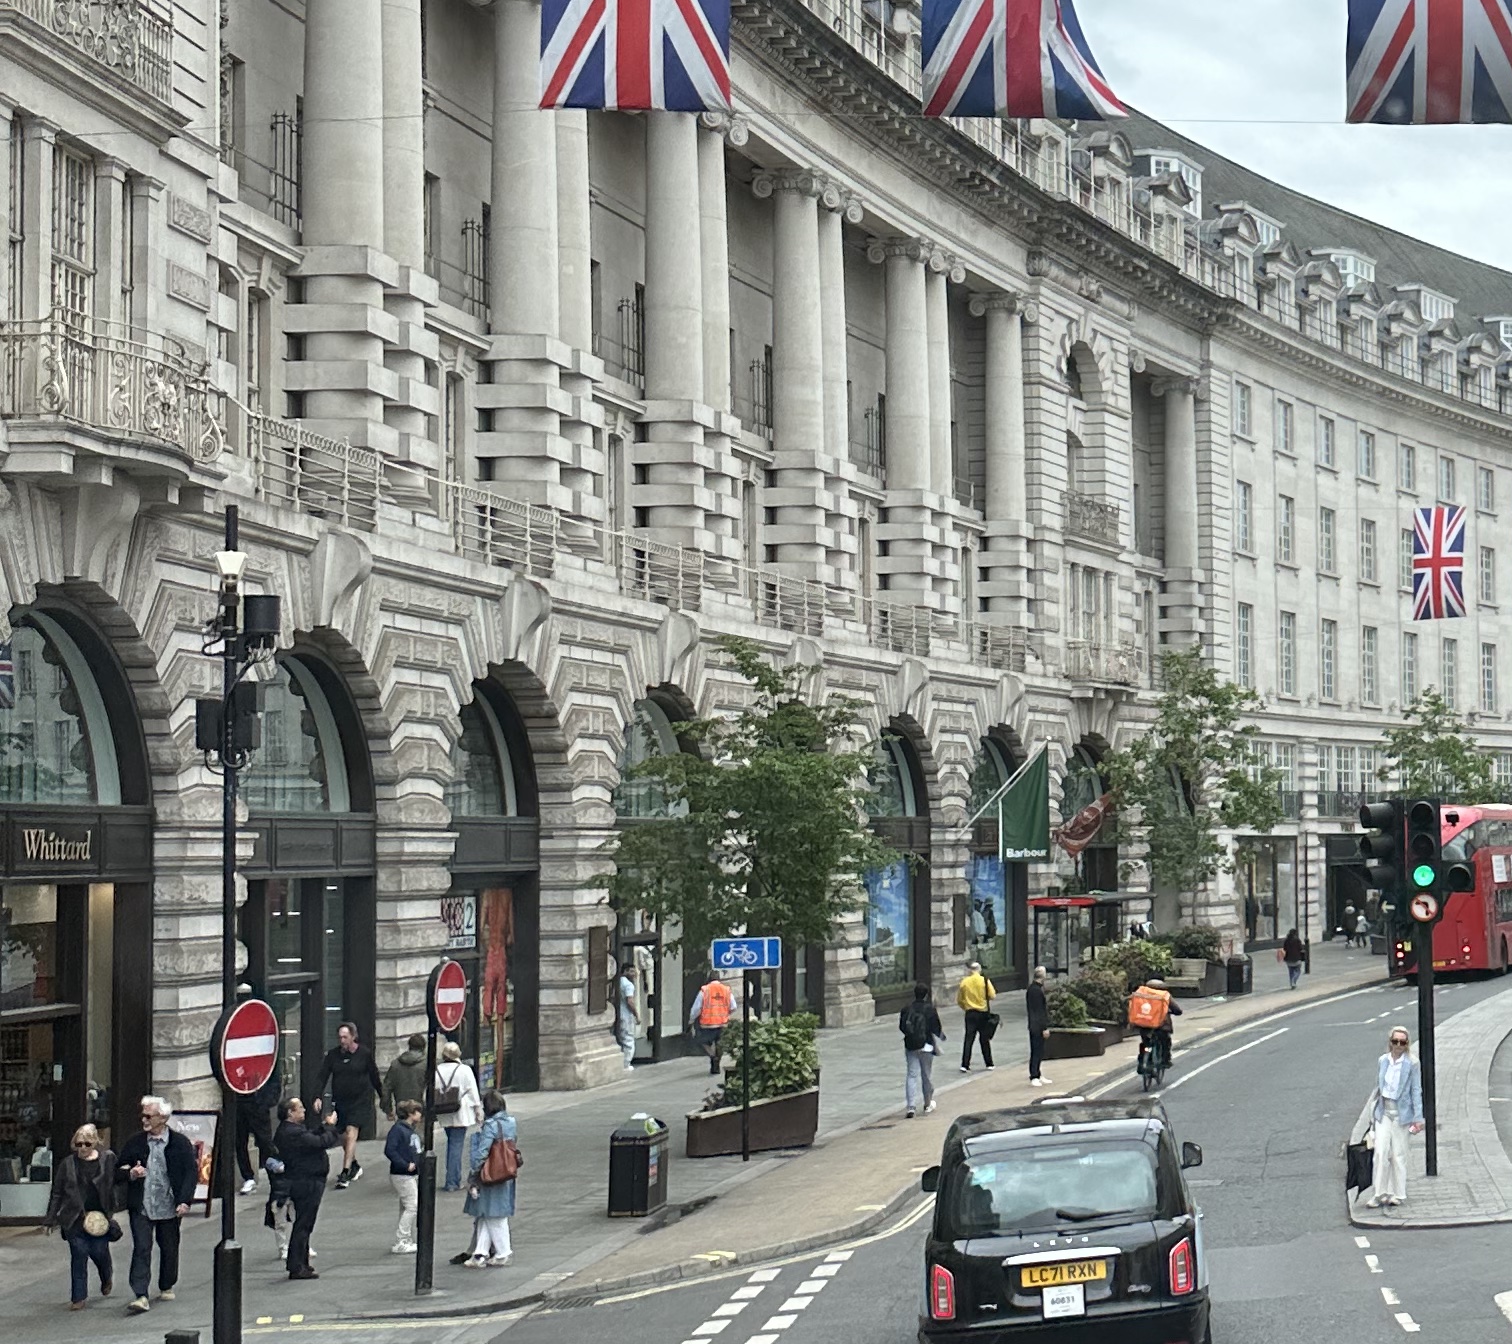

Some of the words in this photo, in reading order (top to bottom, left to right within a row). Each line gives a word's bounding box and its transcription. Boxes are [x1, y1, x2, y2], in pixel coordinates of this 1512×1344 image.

[23, 828, 92, 861] Whittard
[1006, 847, 1048, 858] Barbour
[1029, 1267, 1064, 1284] LC71
[1067, 1262, 1098, 1279] RXN
